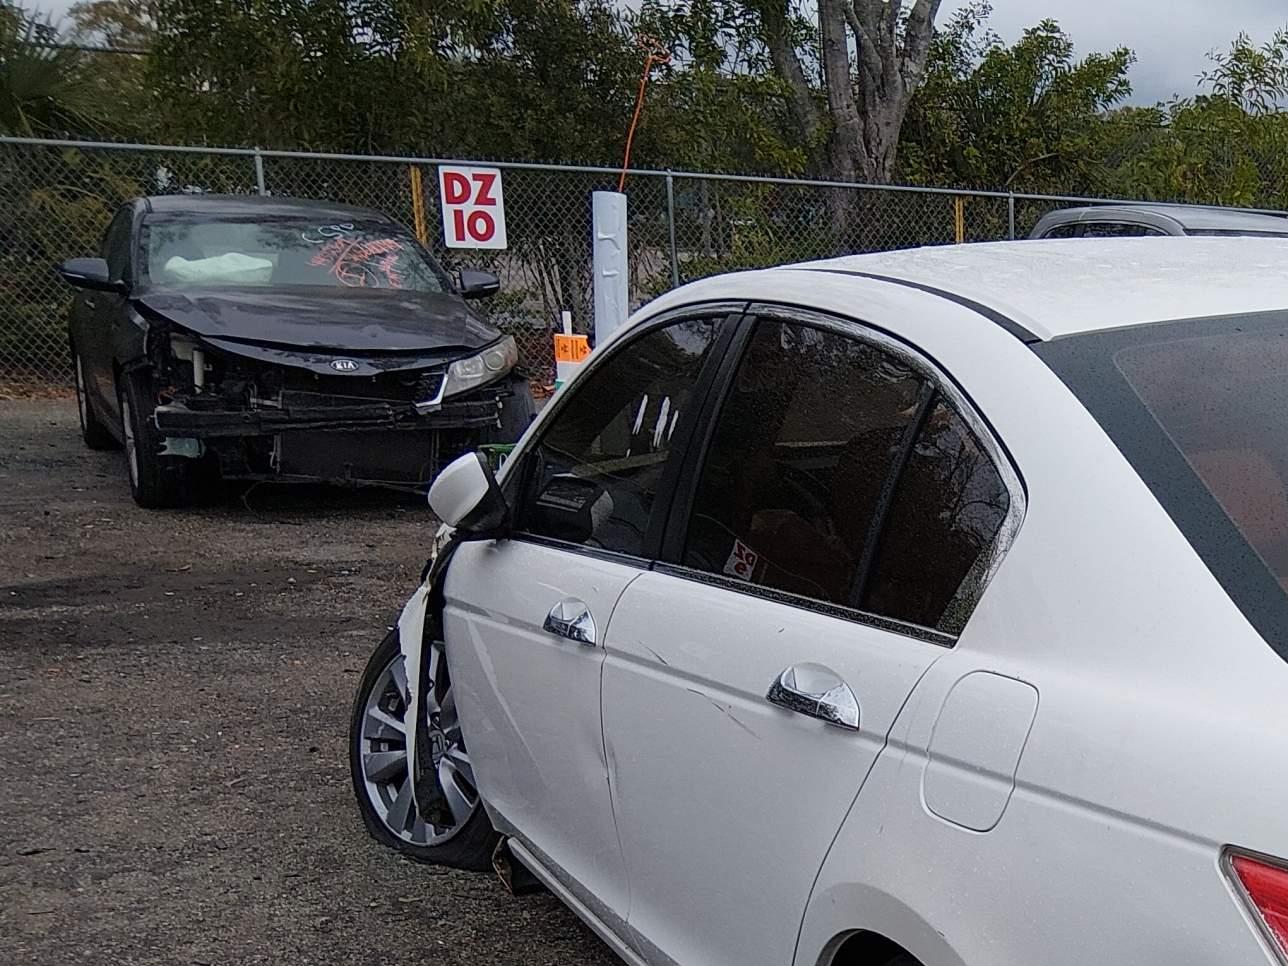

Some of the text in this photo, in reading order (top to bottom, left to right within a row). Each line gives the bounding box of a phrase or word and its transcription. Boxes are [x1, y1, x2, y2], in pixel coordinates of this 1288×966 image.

[443, 172, 497, 206] DZ
[453, 209, 496, 242] 10
[335, 360, 357, 370] KIA
